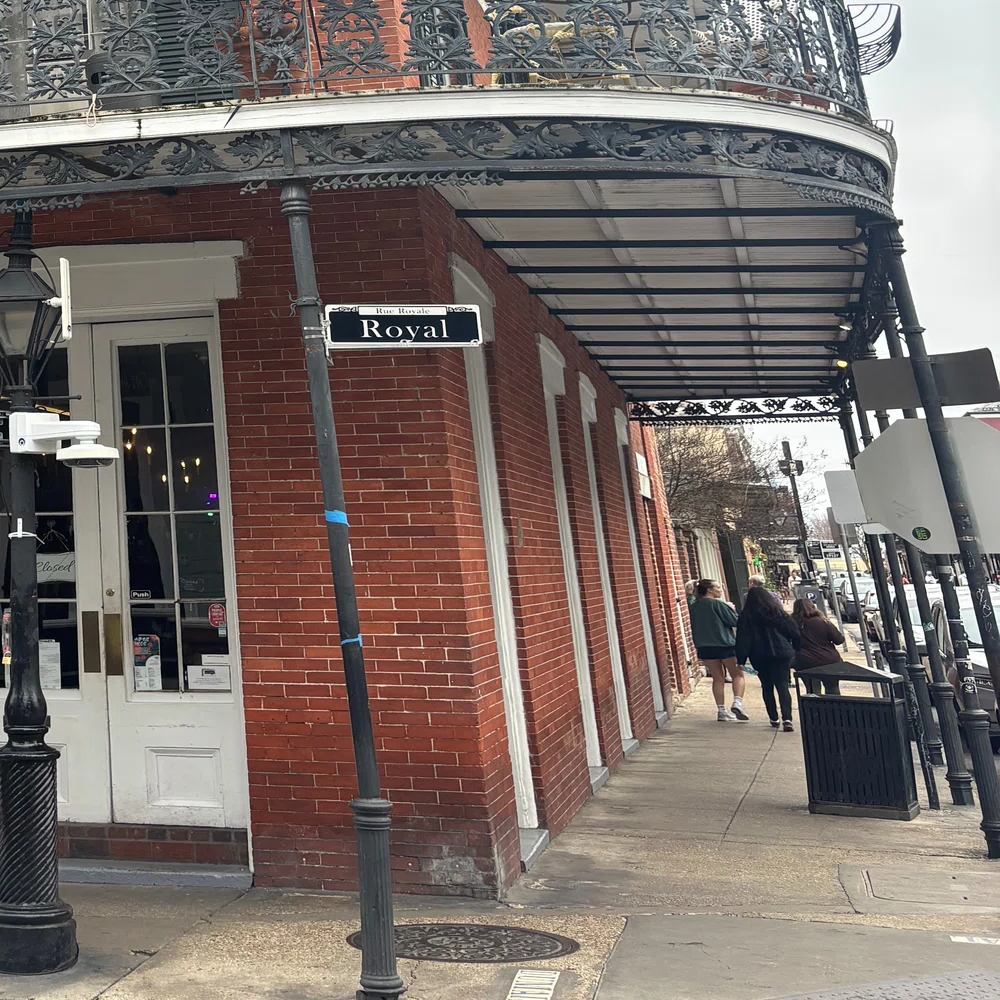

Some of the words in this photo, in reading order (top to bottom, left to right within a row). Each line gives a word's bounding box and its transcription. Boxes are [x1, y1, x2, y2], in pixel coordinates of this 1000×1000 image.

[398, 307, 430, 315] Royale
[360, 319, 449, 342] Royal
[36, 559, 76, 573] Closed
